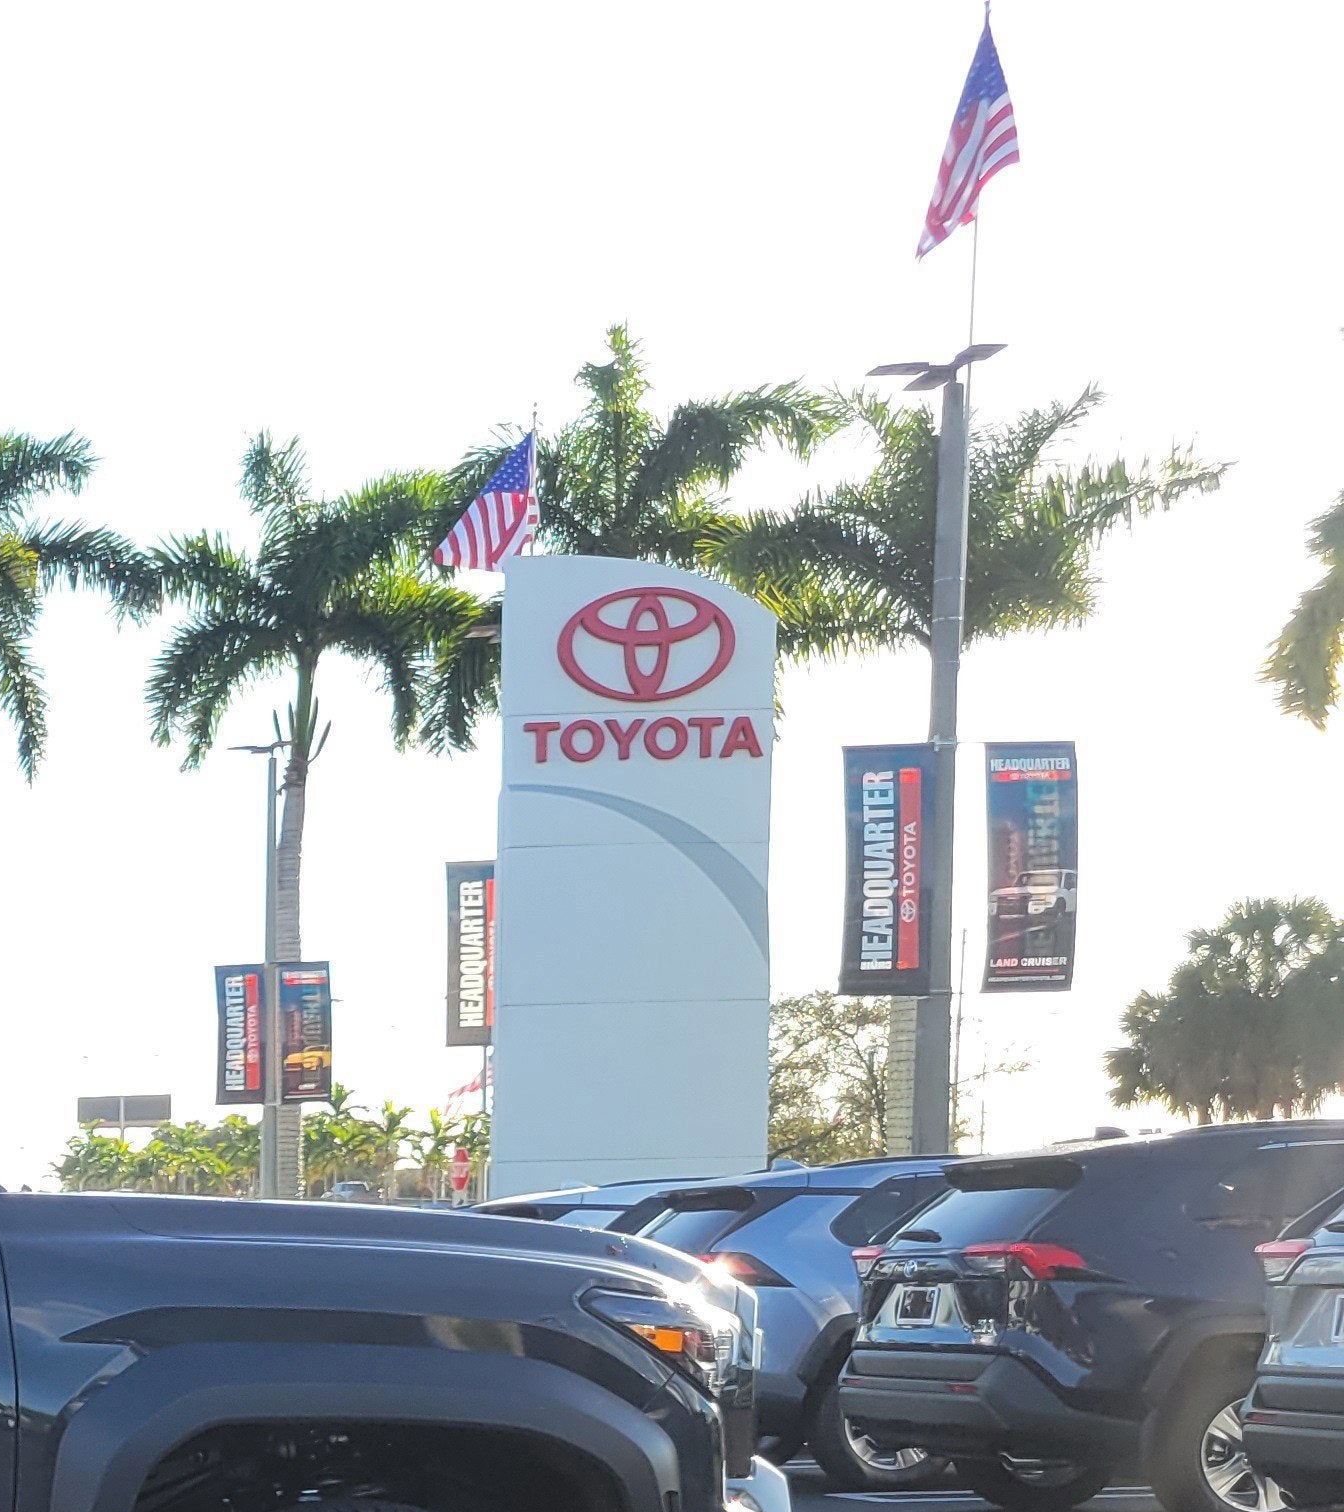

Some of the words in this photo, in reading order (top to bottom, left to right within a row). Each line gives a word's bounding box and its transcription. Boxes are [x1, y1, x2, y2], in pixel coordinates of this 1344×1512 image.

[523, 716, 764, 763] TOYOTA
[990, 757, 1071, 772] HEADQUARTER
[860, 770, 900, 971] HEADQUARTER
[902, 821, 917, 897] TOYOTA
[459, 880, 488, 1028] HEADQUARTER
[989, 958, 1019, 968] LAND
[1020, 956, 1068, 967] CRUISER
[225, 975, 246, 1091] HEADQUARTER
